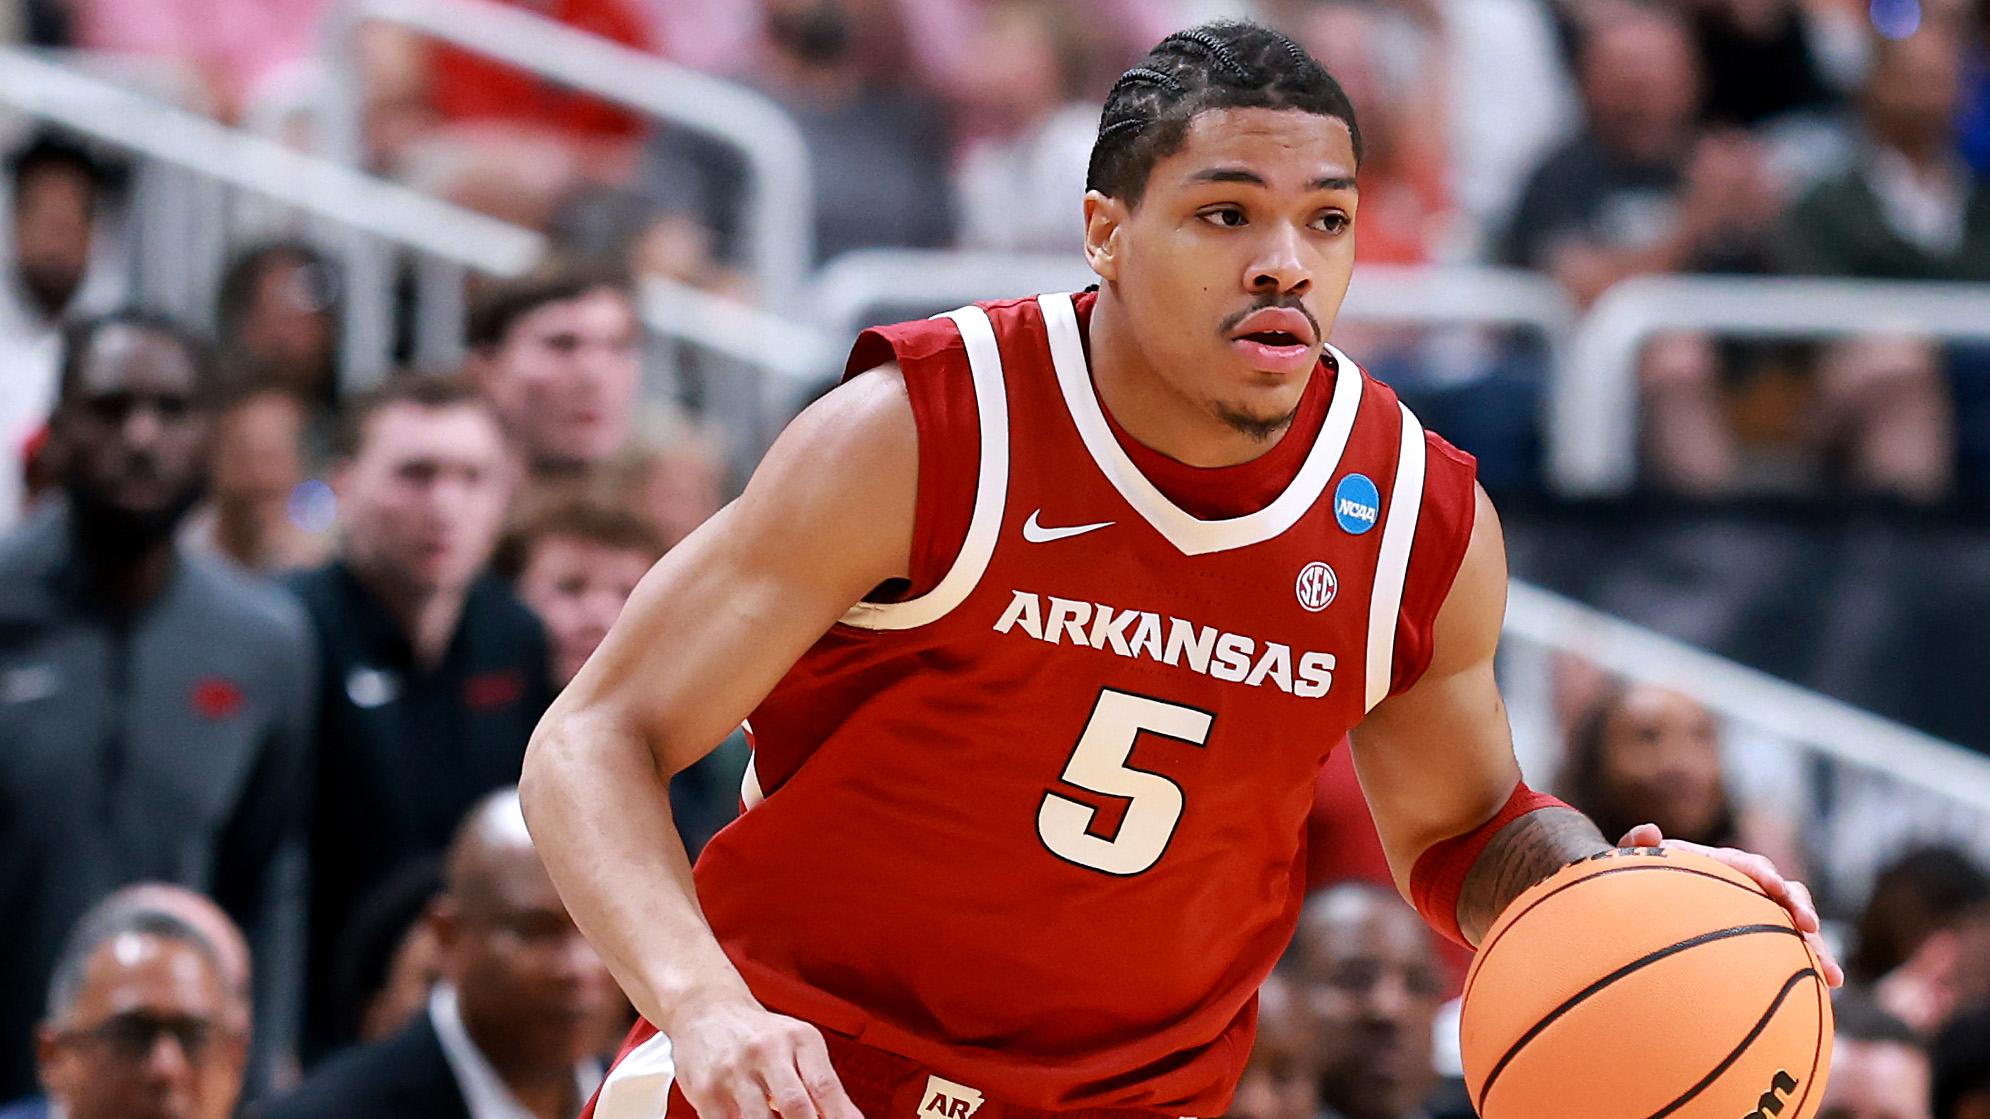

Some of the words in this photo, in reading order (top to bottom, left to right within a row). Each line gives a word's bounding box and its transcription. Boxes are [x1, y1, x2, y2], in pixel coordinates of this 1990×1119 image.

[1338, 497, 1376, 523] NCAA
[1300, 566, 1334, 607] SEC
[993, 589, 1336, 698] ARKANSAS
[1036, 688, 1215, 877] 5
[925, 1092, 971, 1119] AR
